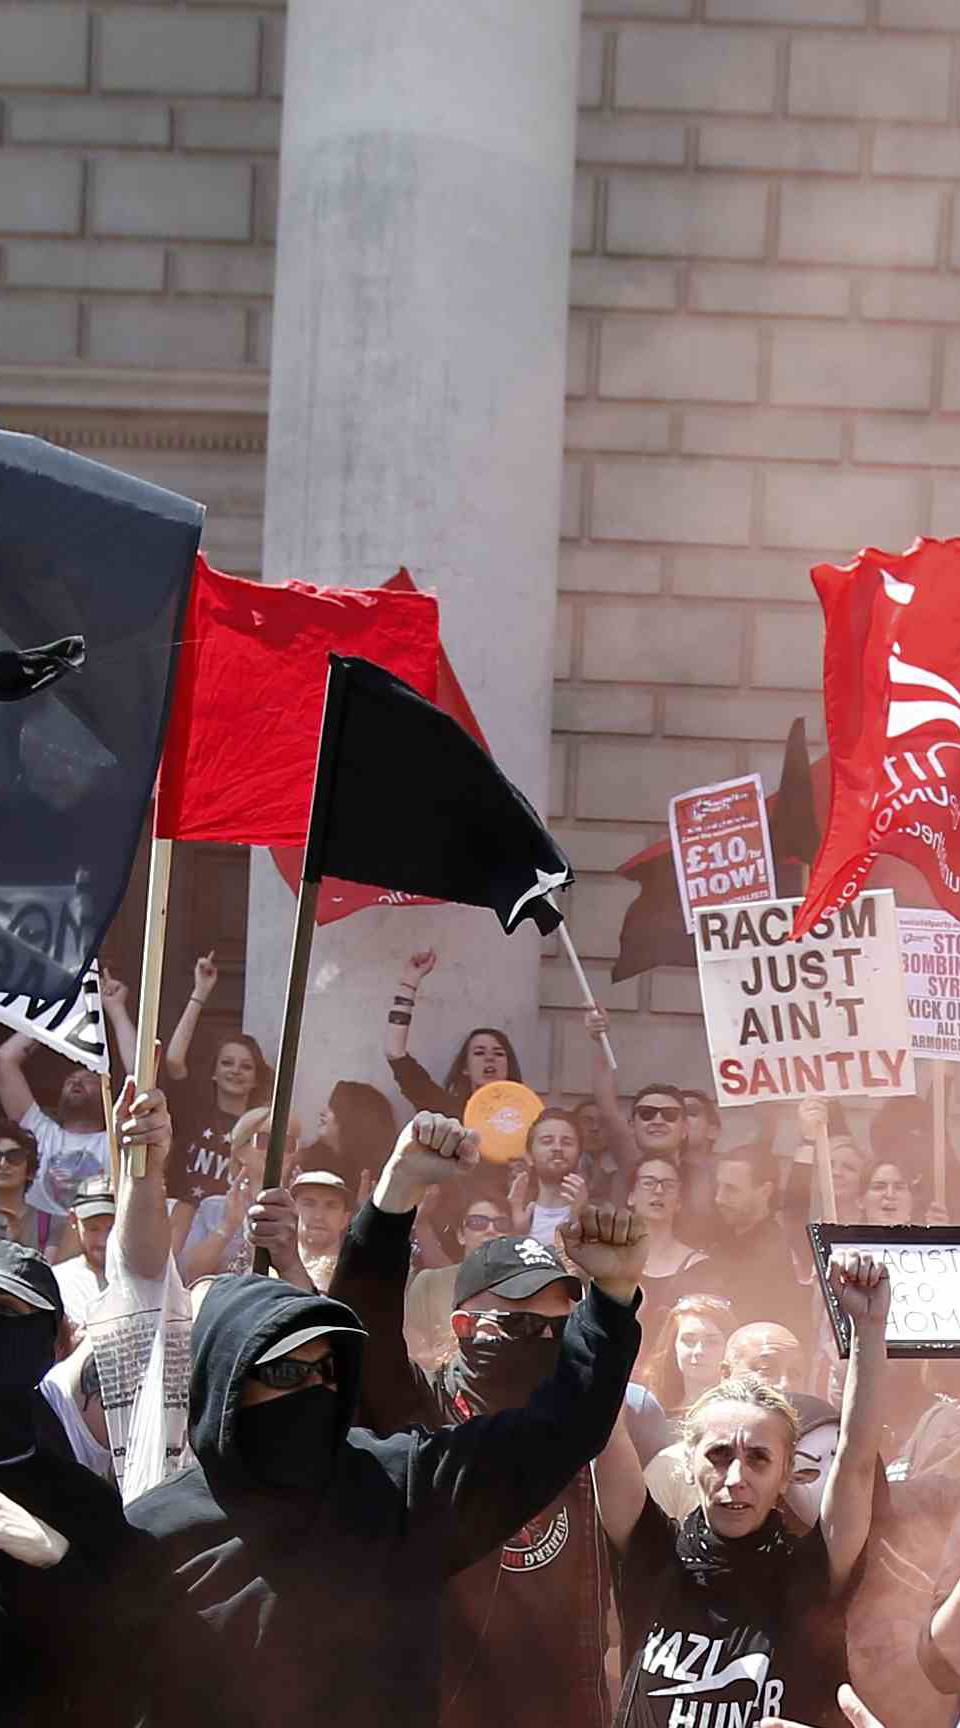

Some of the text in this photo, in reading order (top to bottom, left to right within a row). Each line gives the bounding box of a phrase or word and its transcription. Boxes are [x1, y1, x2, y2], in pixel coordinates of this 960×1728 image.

[686, 836, 747, 874] £10
[740, 948, 862, 996] JUST
[739, 991, 864, 1046] AIN'T
[946, 1002, 960, 1021] O
[718, 1048, 907, 1096] SAINTLY
[882, 1247, 960, 1275] ACIST
[891, 1281, 936, 1305] GO
